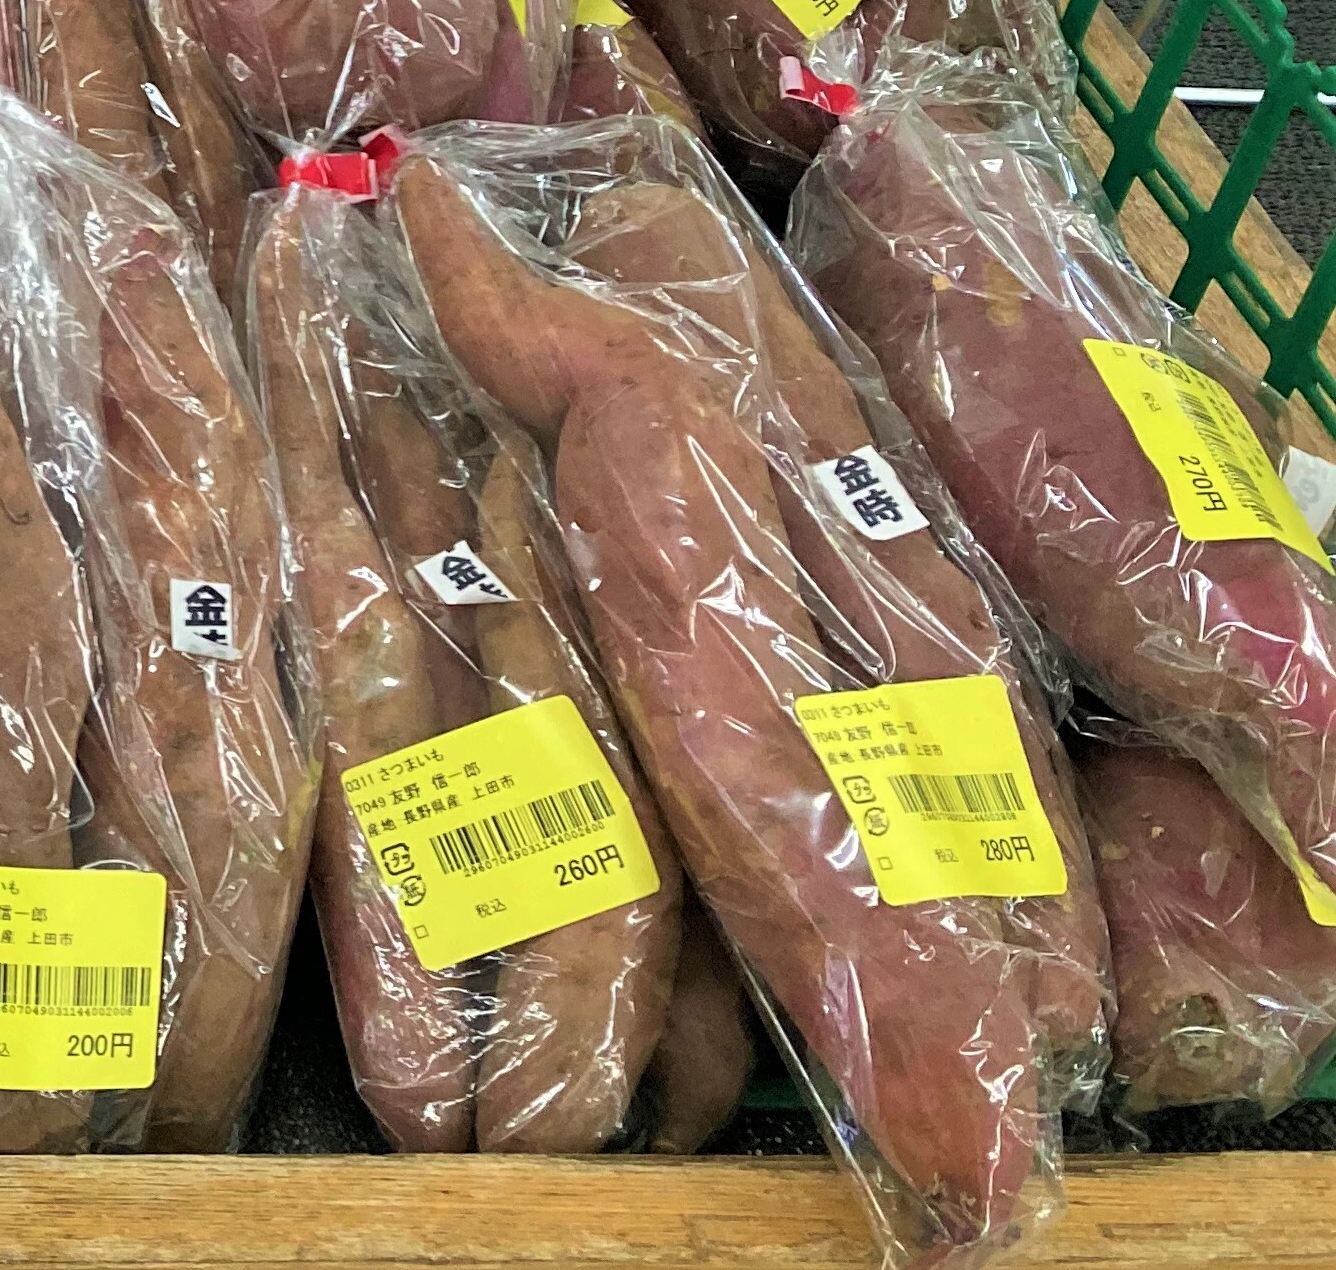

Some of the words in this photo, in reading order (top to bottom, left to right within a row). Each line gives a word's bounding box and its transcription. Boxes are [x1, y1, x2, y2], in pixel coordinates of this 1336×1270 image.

[834, 455, 905, 532] 金時
[1178, 454, 1228, 512] 270円
[186, 584, 229, 647] 金
[345, 774, 376, 793] 0311
[378, 748, 445, 782] さつまいも
[356, 796, 387, 815] 7049
[389, 782, 422, 806] 友野
[431, 761, 482, 791] 信一郎
[471, 774, 516, 801] 上田市
[554, 843, 625, 887] 260円
[981, 836, 1035, 862] 280円
[474, 898, 508, 918] 税込
[27, 932, 74, 946] 上田市
[67, 1032, 134, 1058] 200円
